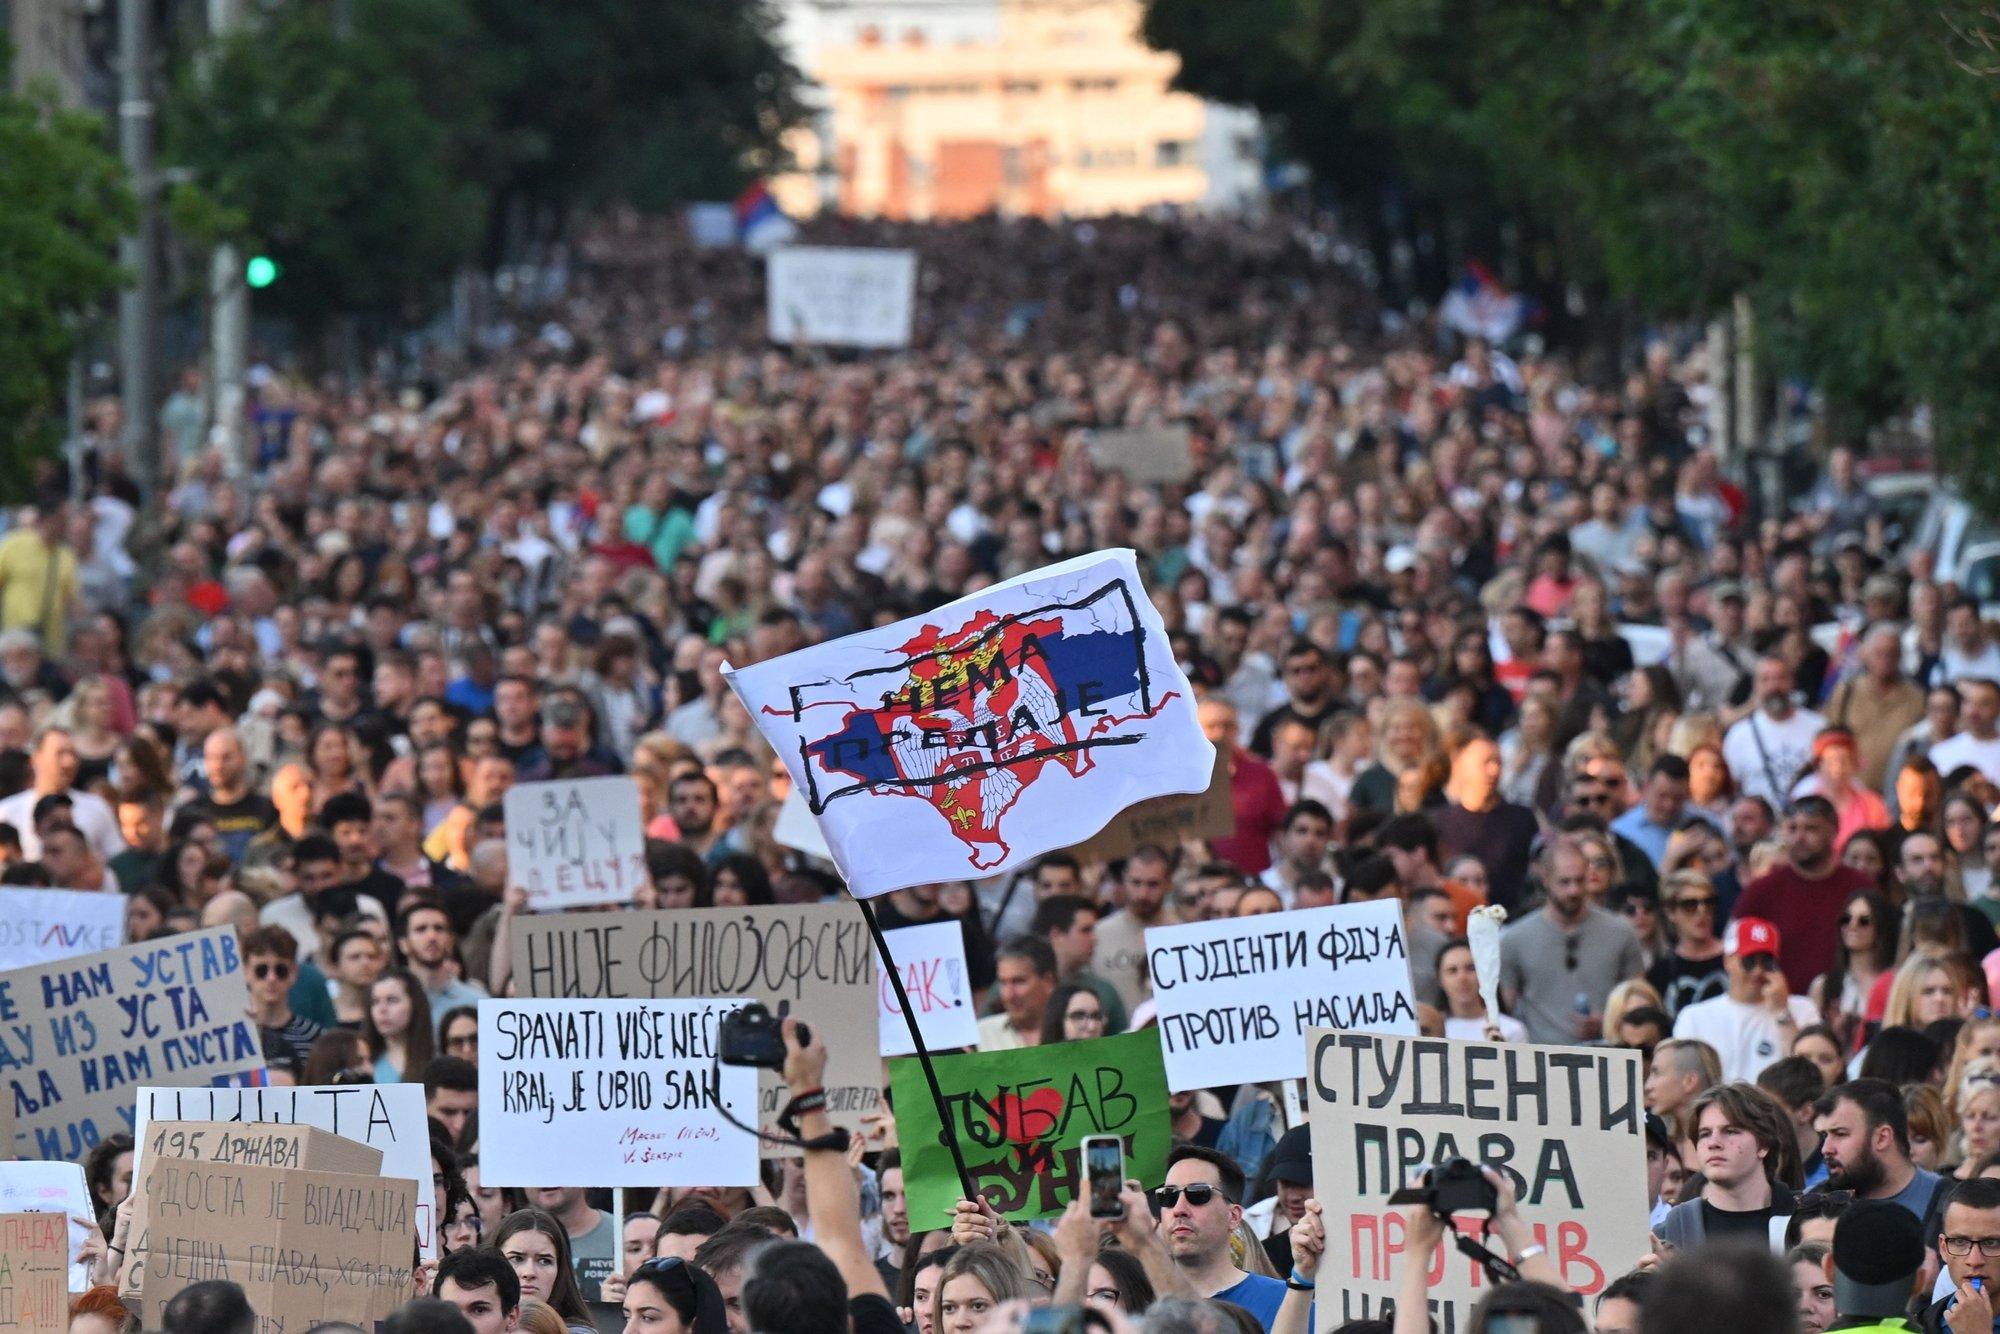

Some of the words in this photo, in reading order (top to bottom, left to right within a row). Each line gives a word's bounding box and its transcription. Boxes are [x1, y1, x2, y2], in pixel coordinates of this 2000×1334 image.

[539, 787, 590, 827] ЗА
[515, 818, 620, 867] ЧИЈУ
[41, 962, 114, 1009] НАМ
[130, 934, 240, 988] УСТАВ
[528, 925, 629, 998] НИЈЕ
[639, 914, 871, 1000] ФИЛОЗОФСКИ
[876, 957, 962, 1015] САК!
[1150, 930, 1307, 990] СТУДЕНТИ
[50, 1009, 98, 1057] ИЗ
[117, 985, 209, 1039] УСТА
[497, 1009, 603, 1061] SPAVATI
[616, 1005, 665, 1060] VIŠE
[1162, 1004, 1280, 1054] ПРОТИВ
[1293, 990, 1415, 1035] НАСИЉА
[80, 1044, 152, 1095] НАМ
[162, 1020, 257, 1073] ПУСТА
[1314, 1033, 1639, 1136] СТУДЕНТИ
[563, 1069, 588, 1112] JE
[597, 1070, 651, 1111] UBIO
[152, 1128, 206, 1159] 195
[210, 1132, 299, 1169] ДРЖАВА
[966, 1132, 1137, 1214] БУН
[160, 1167, 246, 1218] ДОСТА
[263, 1180, 289, 1221] ЈЕ
[303, 1182, 407, 1236] ВЛАДАЛА
[154, 1235, 229, 1286] ЈЕДНА
